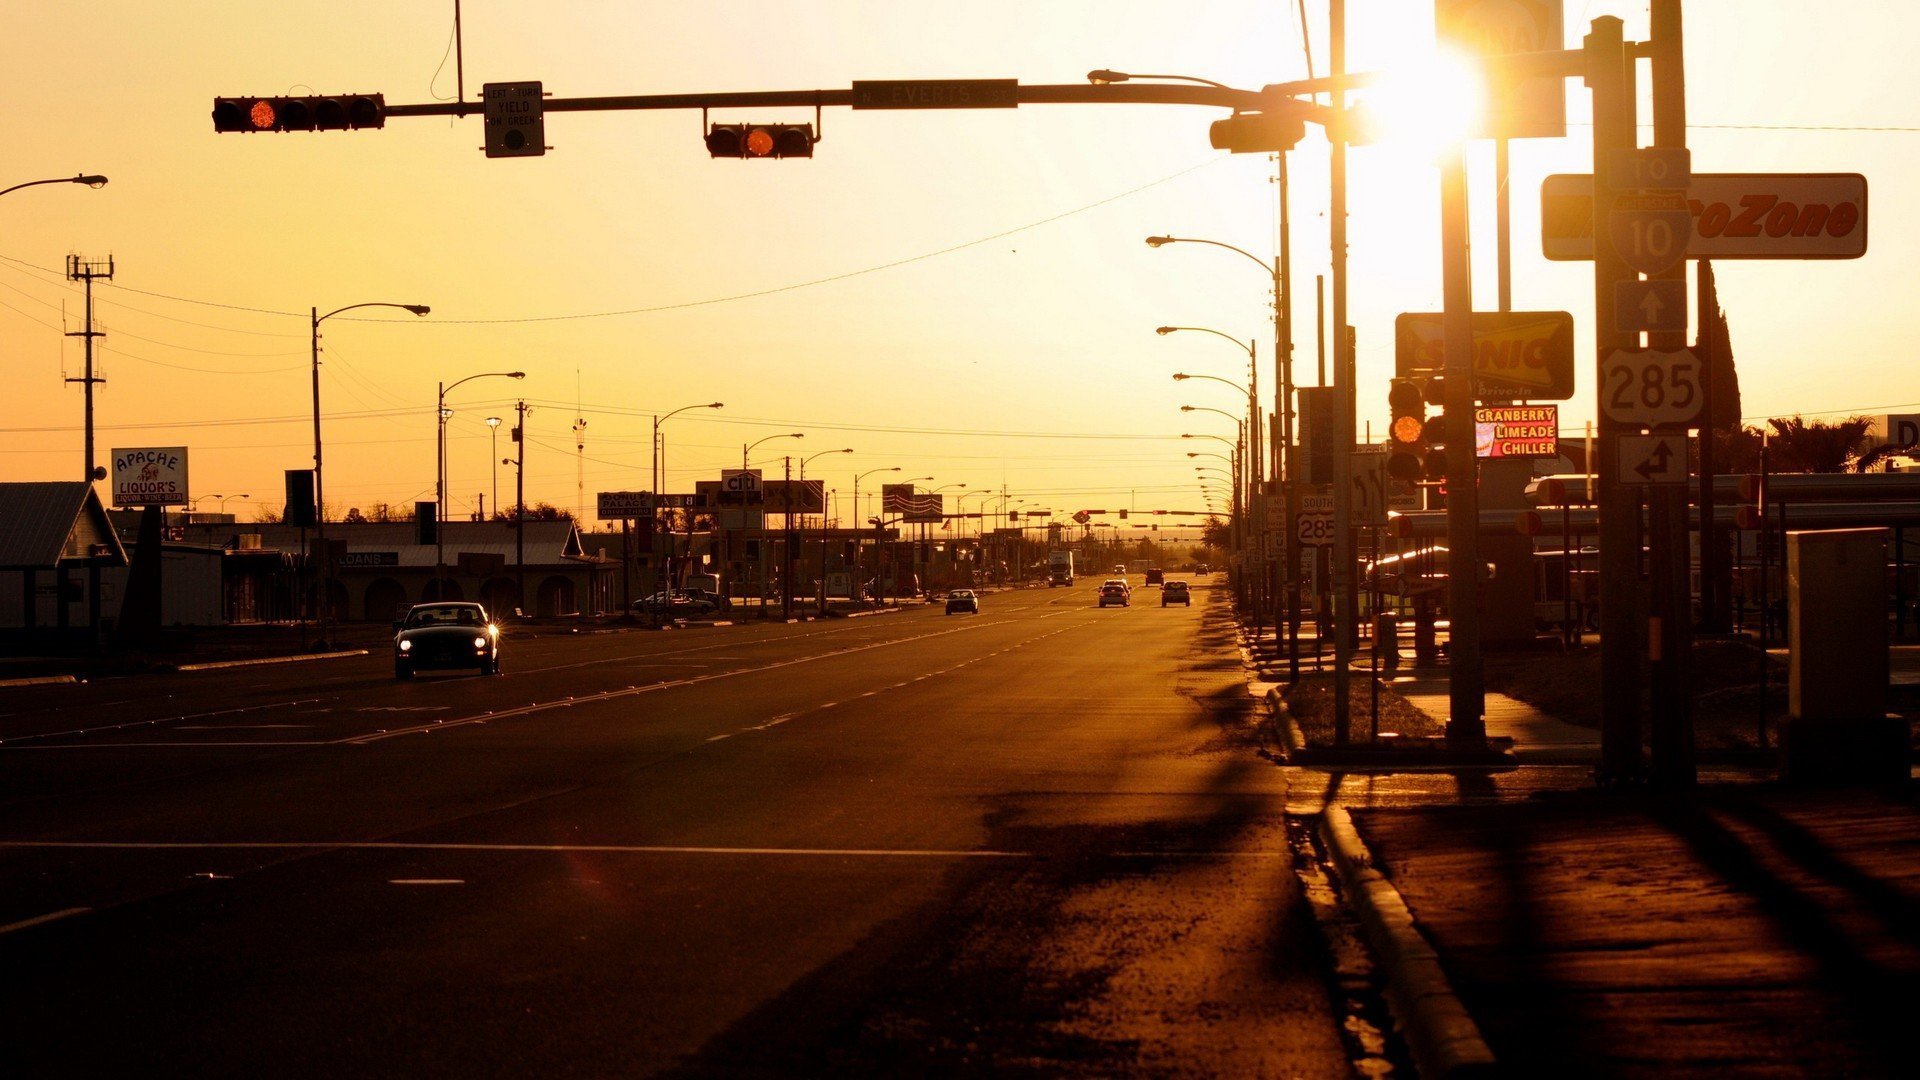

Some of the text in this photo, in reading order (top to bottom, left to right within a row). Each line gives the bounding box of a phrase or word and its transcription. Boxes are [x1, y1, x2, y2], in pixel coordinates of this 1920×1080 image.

[487, 88, 539, 99] LEFT TURN
[893, 87, 970, 102] EVERTS
[498, 101, 530, 113] YIELD
[491, 116, 535, 126] ON GREEN
[1629, 157, 1668, 180] TO
[1618, 199, 1681, 210] INTERSTATE
[1630, 219, 1672, 256] 10
[1609, 364, 1694, 408] 285
[1475, 409, 1554, 422] CRANBERRY
[1495, 426, 1555, 438] LIMEADE
[1501, 442, 1555, 454] CHILLER
[116, 451, 179, 472] APACHE
[120, 481, 176, 494] LIQUOR'S
[116, 493, 182, 503] LIQUOR WINE BEER
[1303, 497, 1334, 508] SOUTH
[1300, 520, 1335, 539] 285
[339, 554, 382, 565] LOANS
